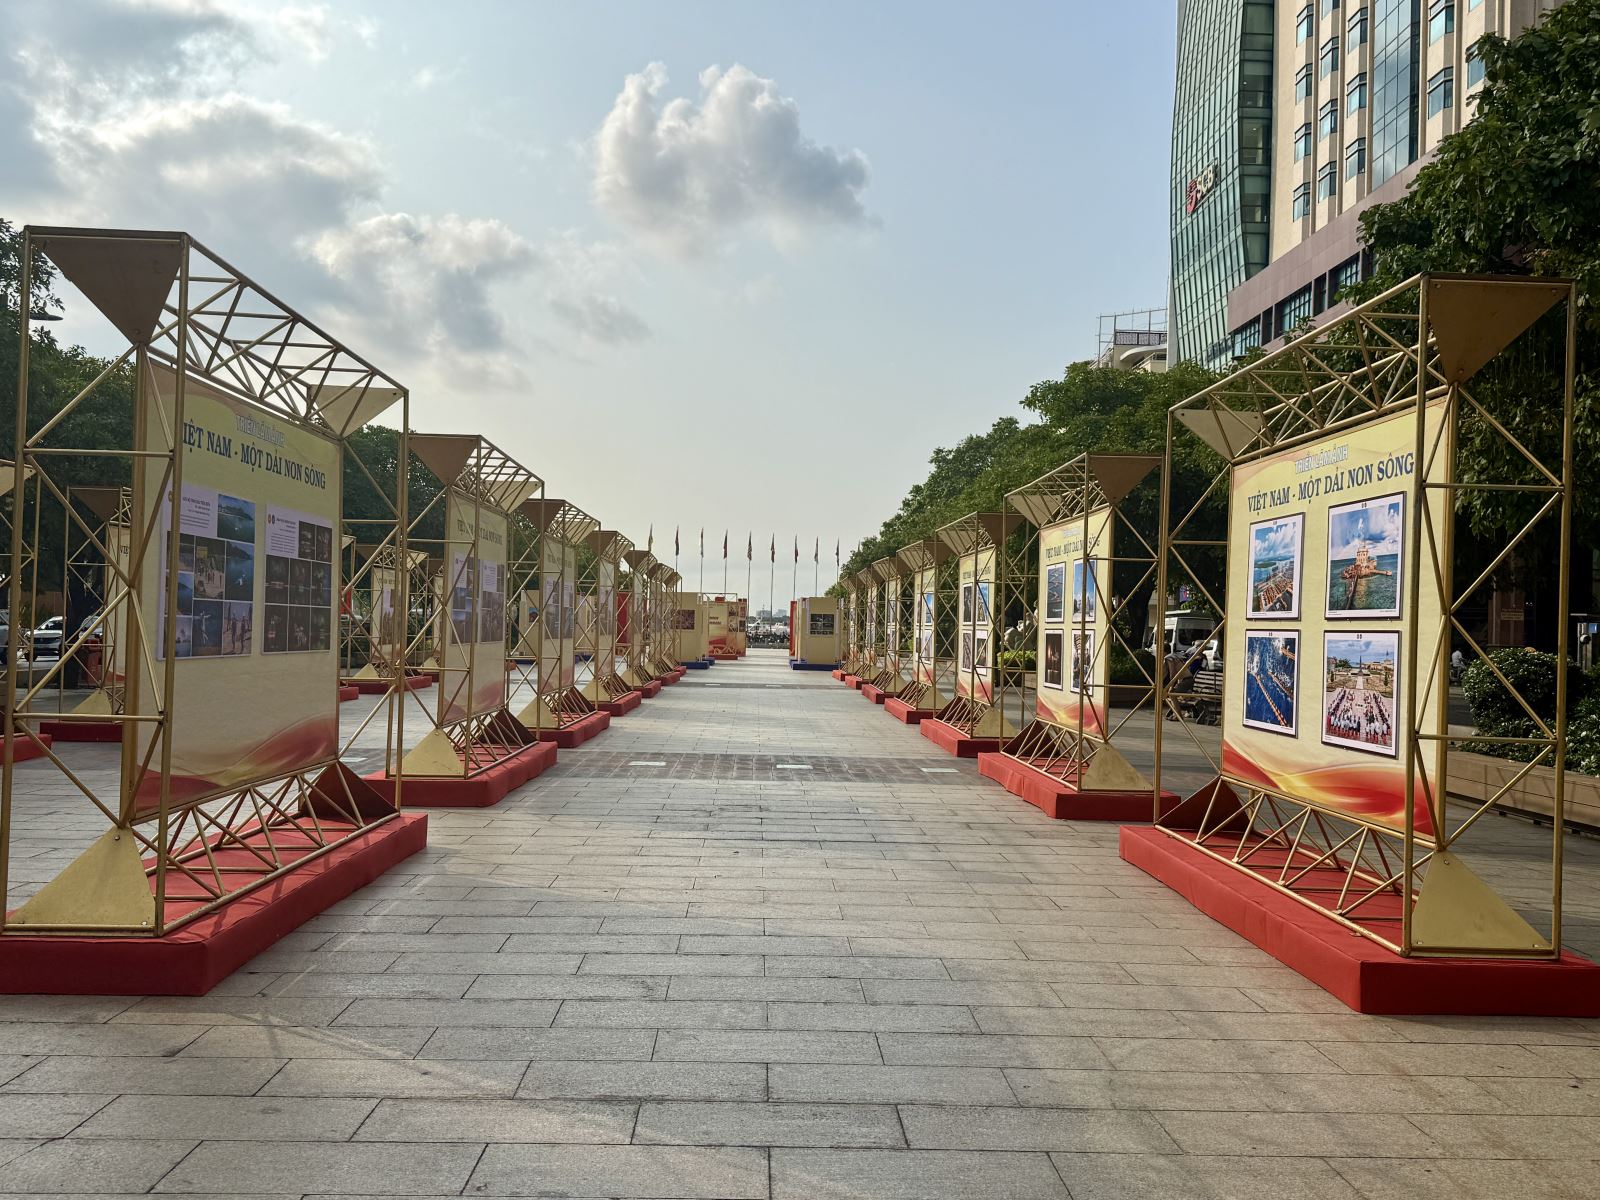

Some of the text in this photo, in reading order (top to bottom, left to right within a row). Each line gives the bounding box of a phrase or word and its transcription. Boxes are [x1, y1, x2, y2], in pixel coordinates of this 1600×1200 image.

[1196, 165, 1214, 200] SCB
[183, 418, 204, 453] IỆT
[207, 431, 232, 459] NAM
[240, 442, 264, 473] MỘT
[265, 449, 282, 476] DẢI
[284, 459, 302, 482] NON
[304, 465, 327, 490] SÔNG
[1247, 489, 1267, 516] VIỆT
[1270, 486, 1290, 508] NAM
[1297, 475, 1321, 504] MỘT
[1323, 466, 1344, 494] DẢI
[1347, 461, 1373, 489] NON
[1376, 452, 1414, 482] SÔNG
